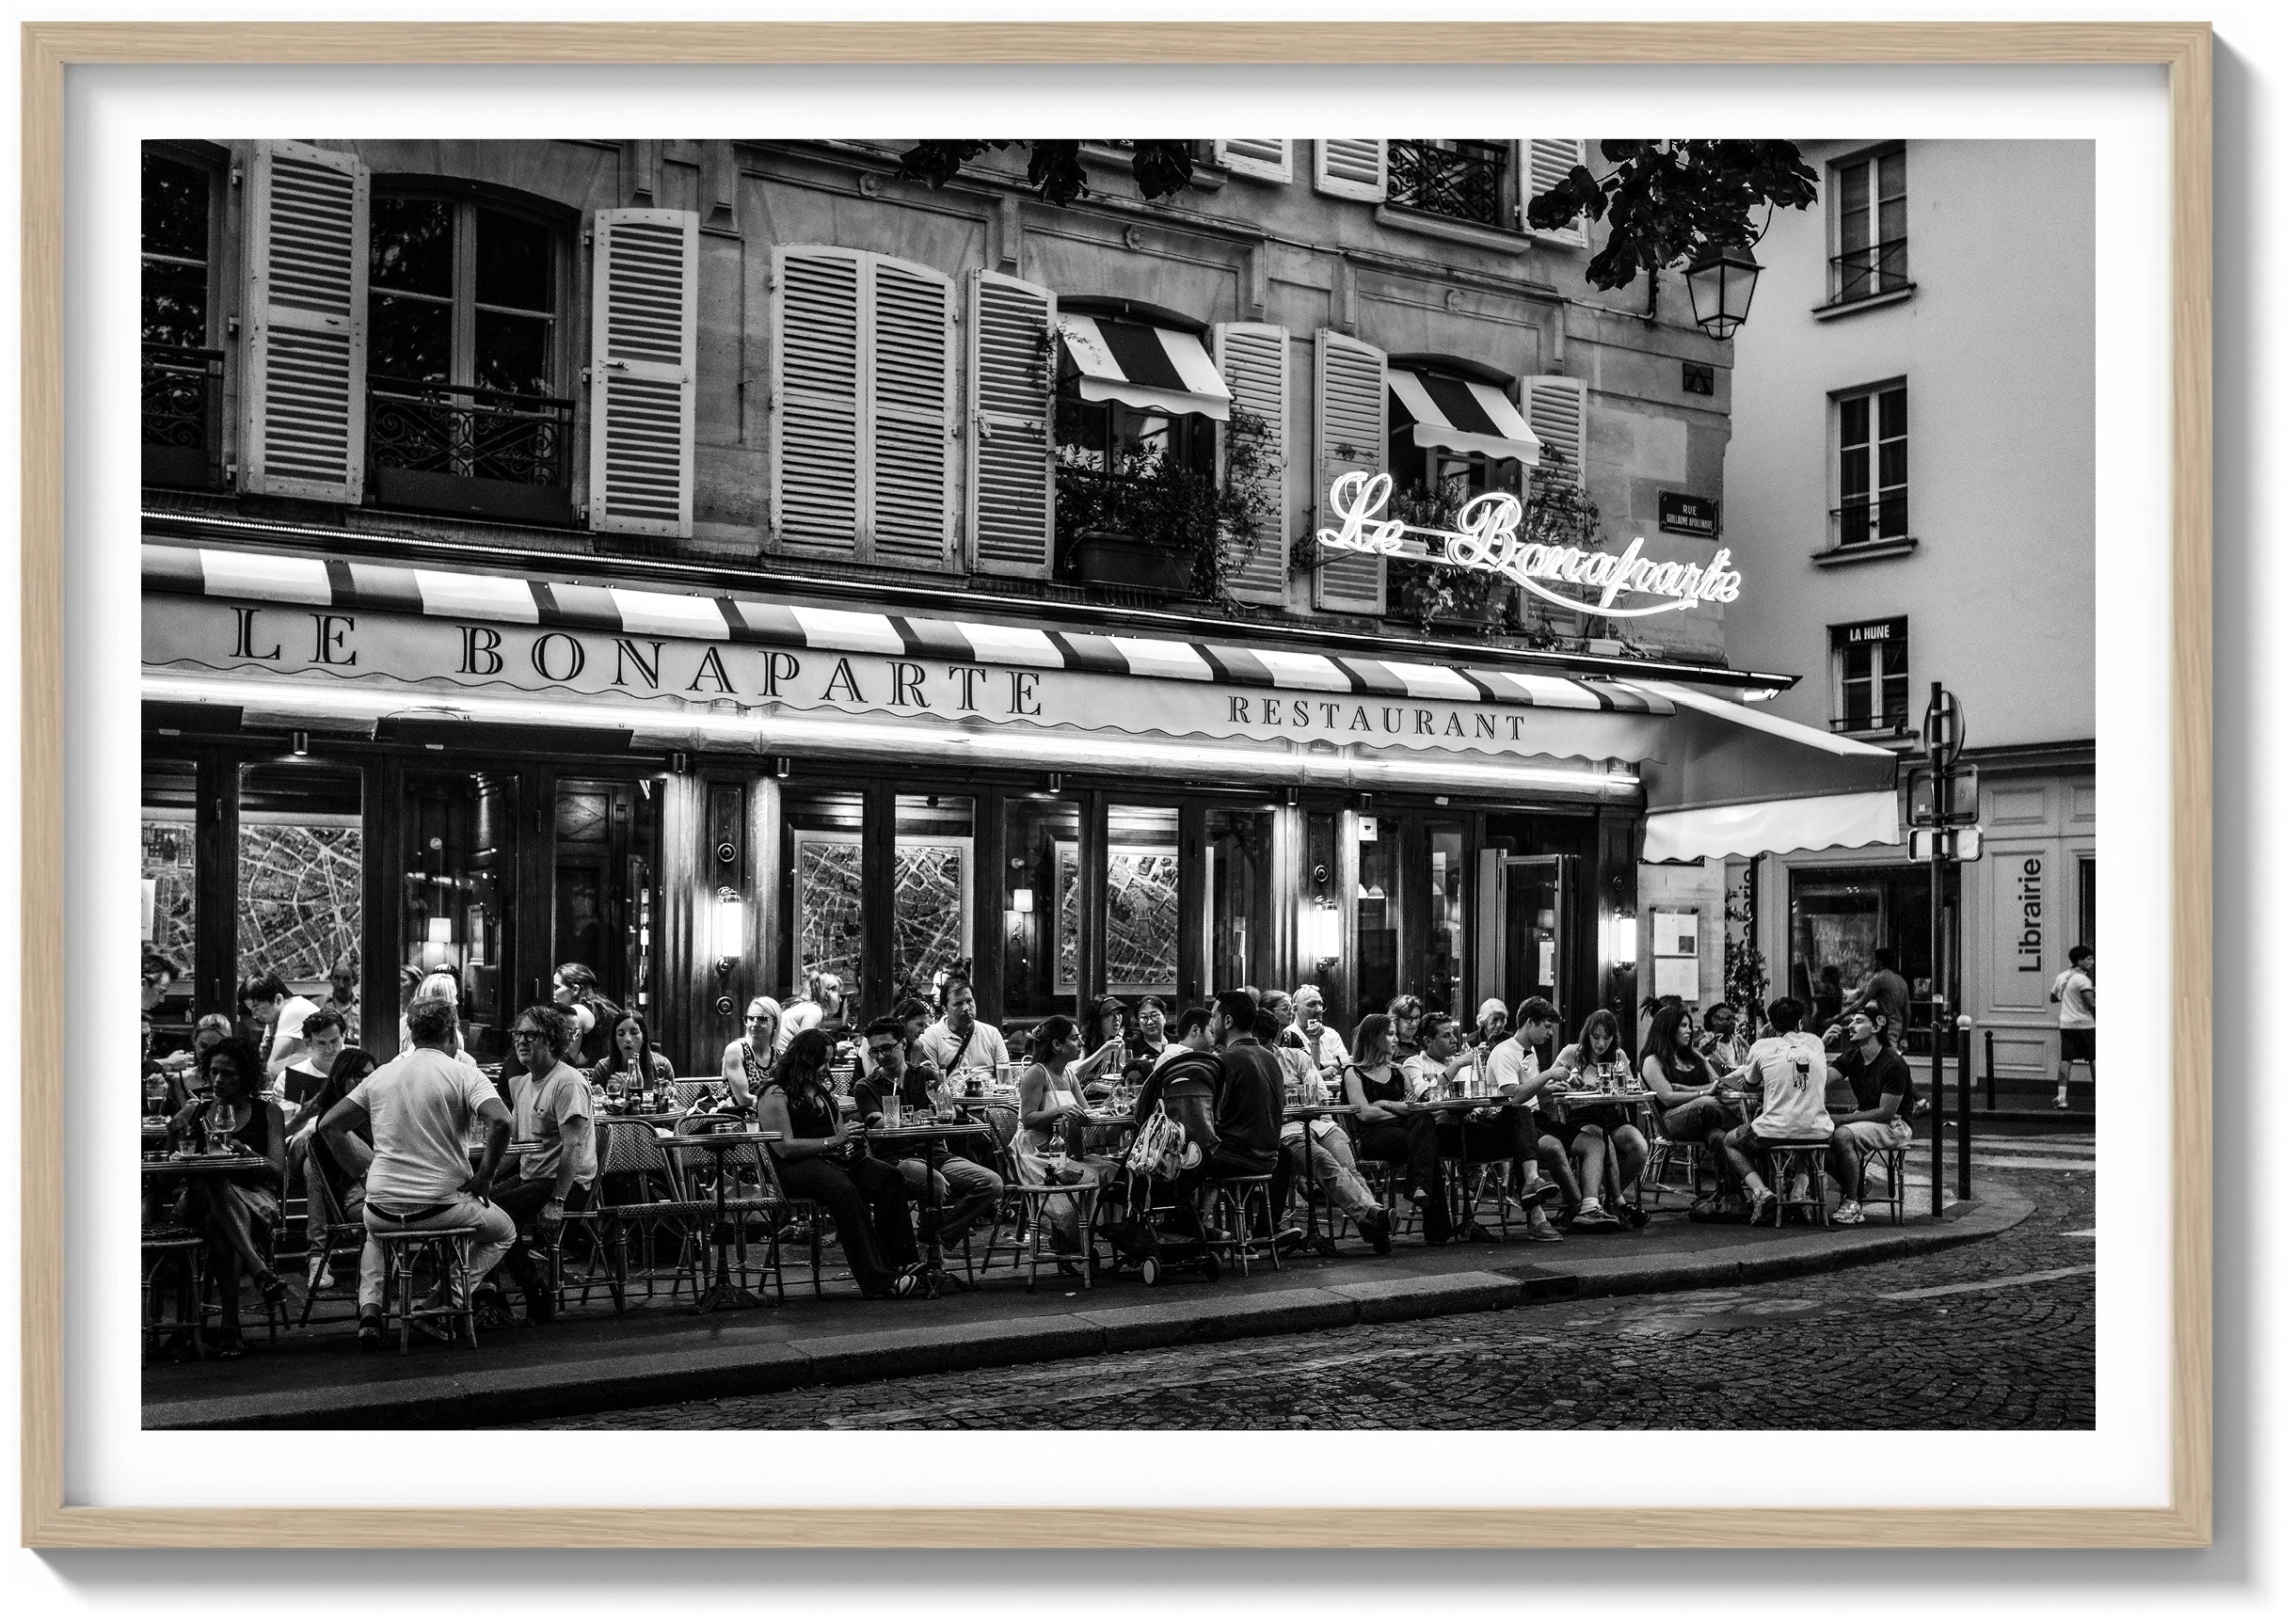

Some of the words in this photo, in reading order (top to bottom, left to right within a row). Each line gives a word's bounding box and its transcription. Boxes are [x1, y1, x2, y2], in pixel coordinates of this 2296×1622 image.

[1316, 471, 1405, 553] Le
[1446, 491, 1743, 617] Bonaparte
[1682, 503, 1698, 516] RUE
[228, 607, 358, 667] LE
[455, 625, 1043, 717] BONAPARTE
[1849, 628, 1862, 643] LA
[1863, 624, 1890, 641] HUNE
[1226, 695, 1525, 741] RESTAURANT
[2018, 857, 2042, 973] Librairie
